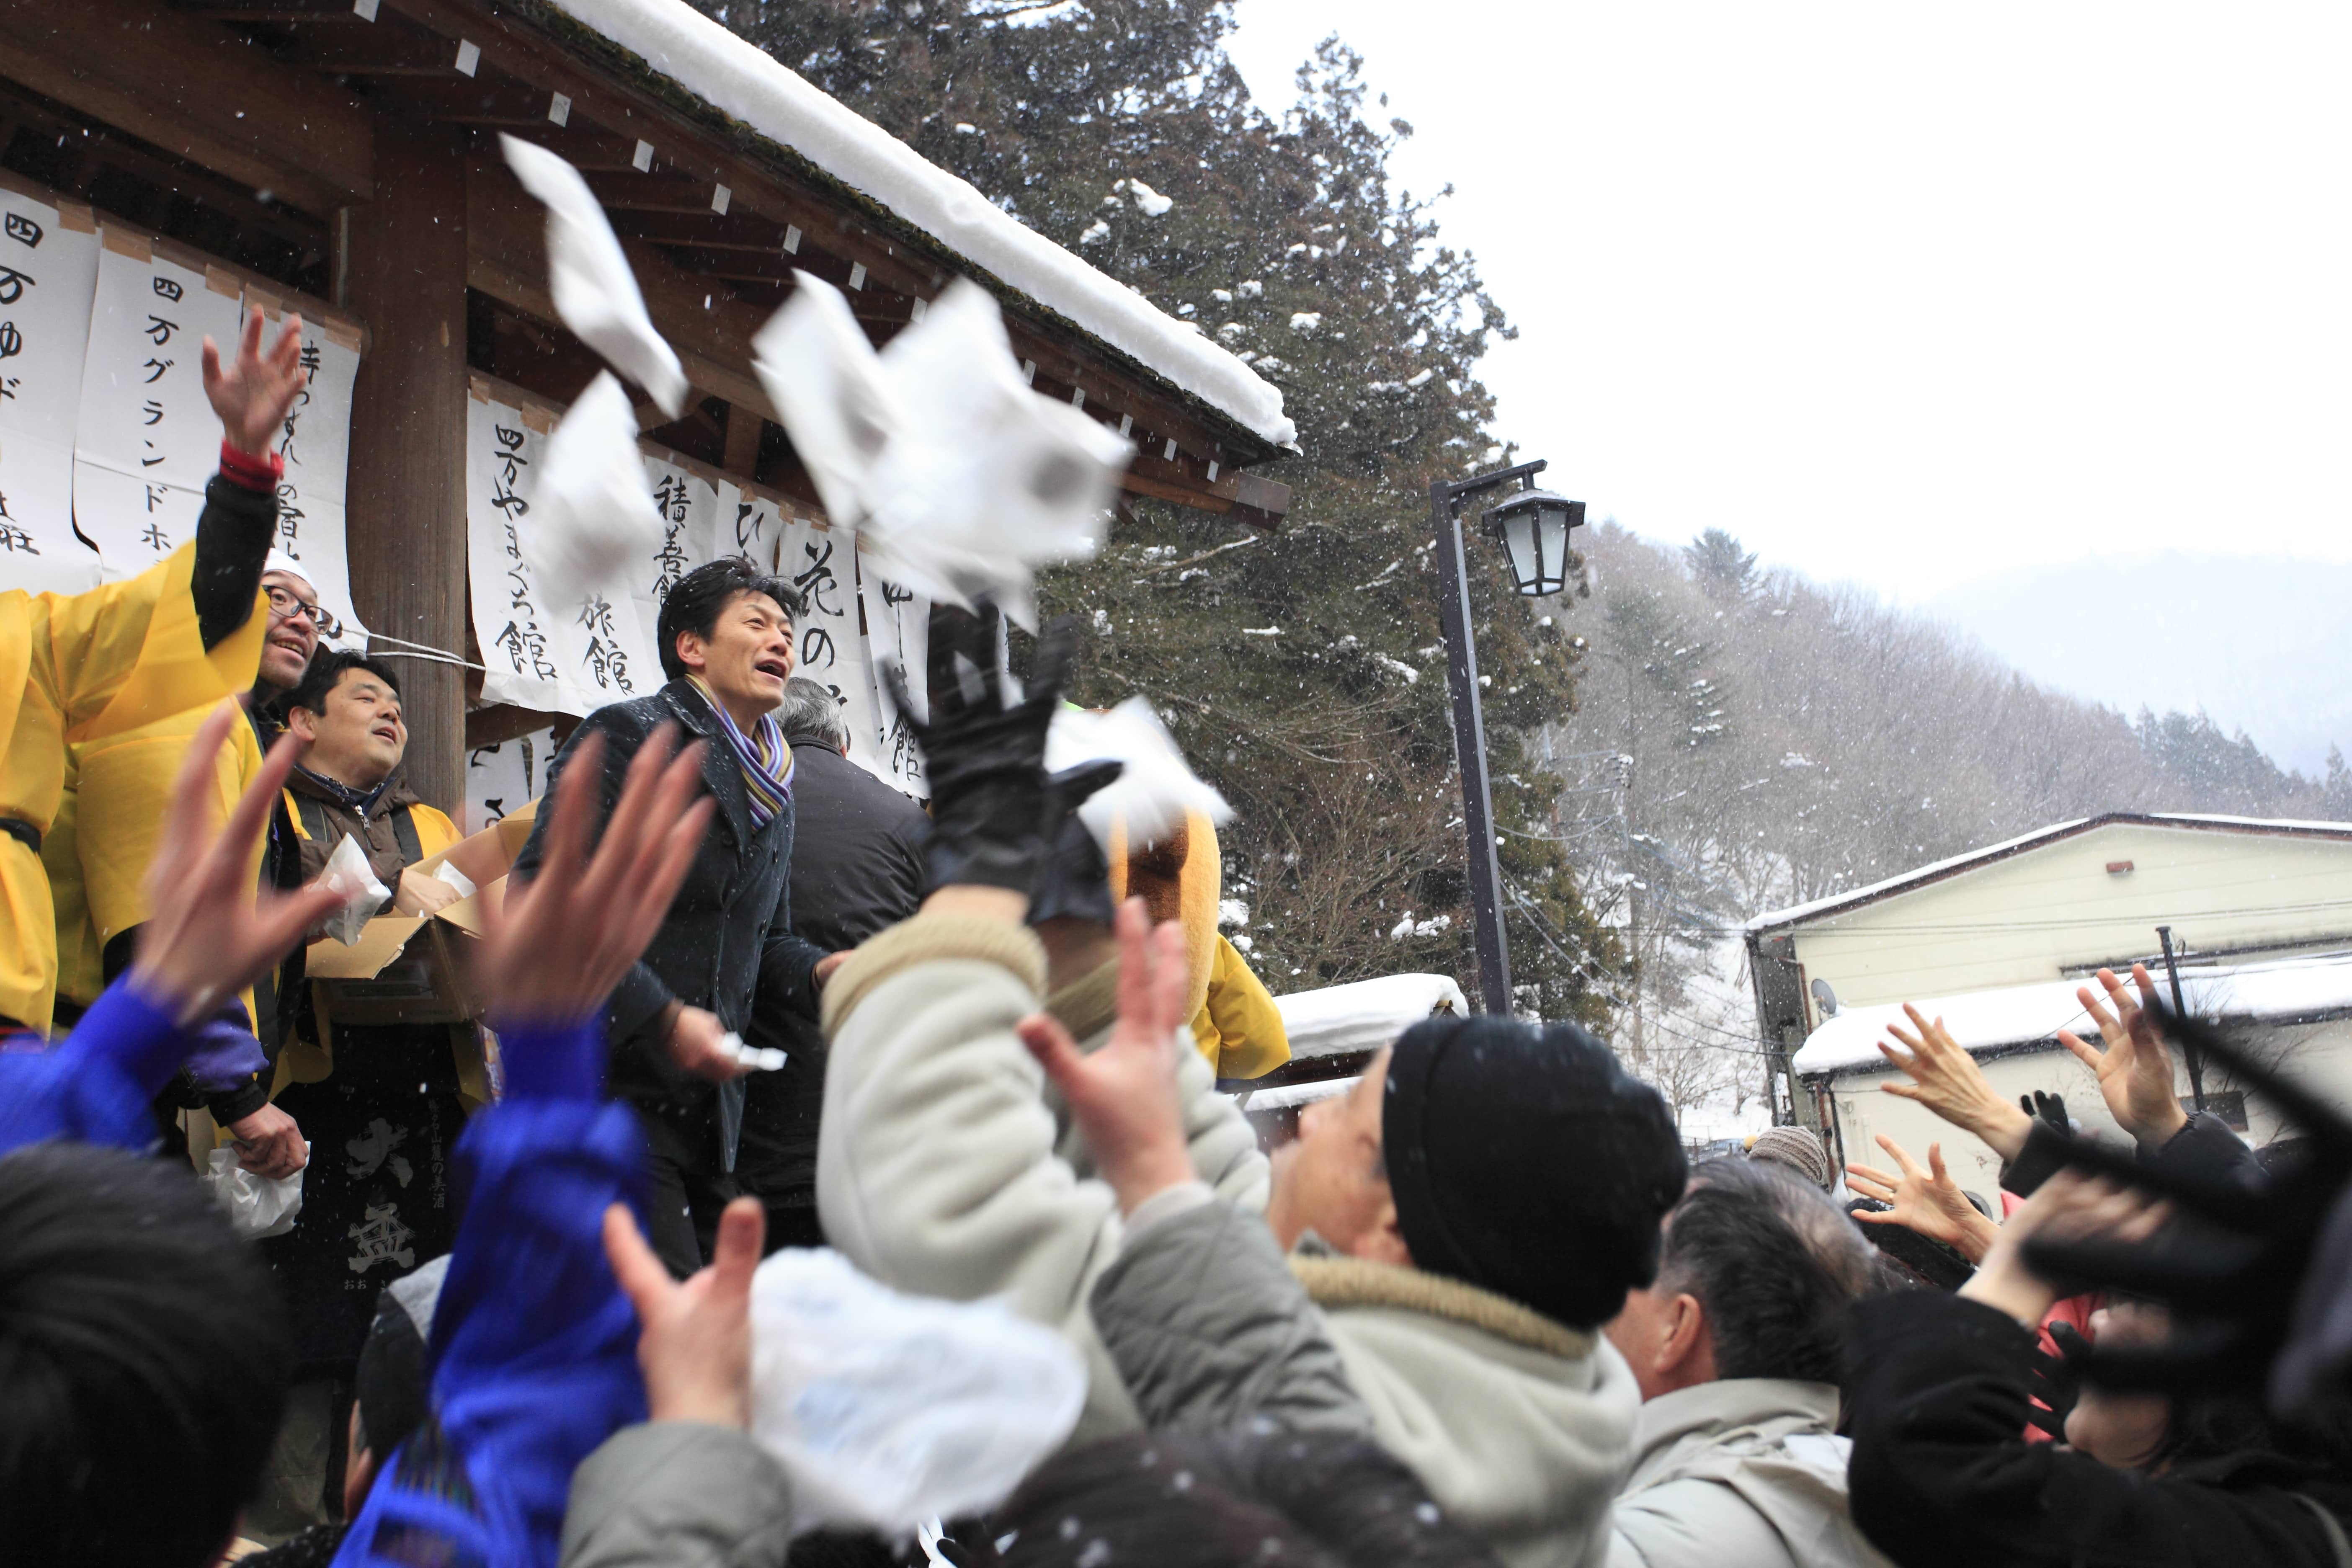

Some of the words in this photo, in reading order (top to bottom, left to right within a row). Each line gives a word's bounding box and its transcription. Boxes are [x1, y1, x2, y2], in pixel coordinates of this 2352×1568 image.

[140, 276, 184, 564] 四万グランドホ
